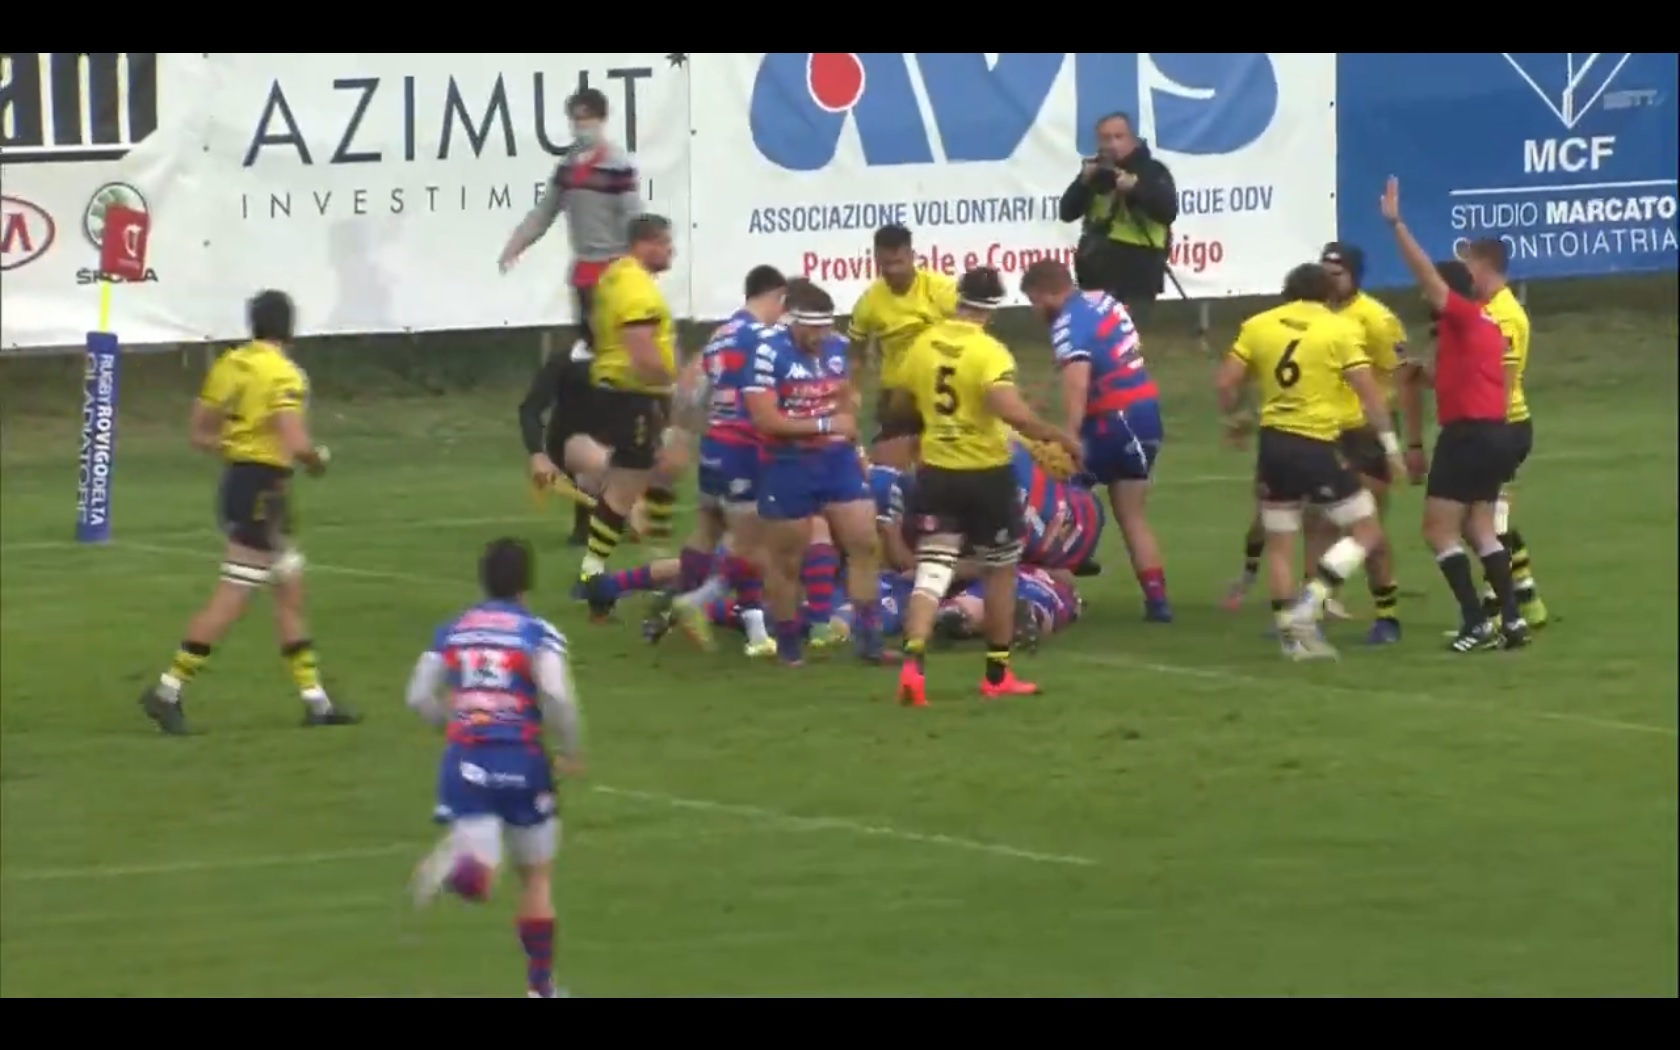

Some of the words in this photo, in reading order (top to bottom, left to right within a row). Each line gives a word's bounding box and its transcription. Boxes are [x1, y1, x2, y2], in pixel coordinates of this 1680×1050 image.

[242, 66, 653, 167] AZIMUT
[1523, 135, 1616, 173] MCF
[242, 177, 655, 219] INVESTIMEI
[748, 202, 907, 235] ASSOCIAZIONE
[913, 195, 1034, 227] VOLONTARI
[1230, 185, 1273, 212] ODV
[1451, 201, 1539, 230] STUDIO
[1545, 195, 1678, 225] MARCATO
[964, 252, 978, 275] e
[1274, 338, 1301, 390] 6
[934, 366, 960, 416] 5
